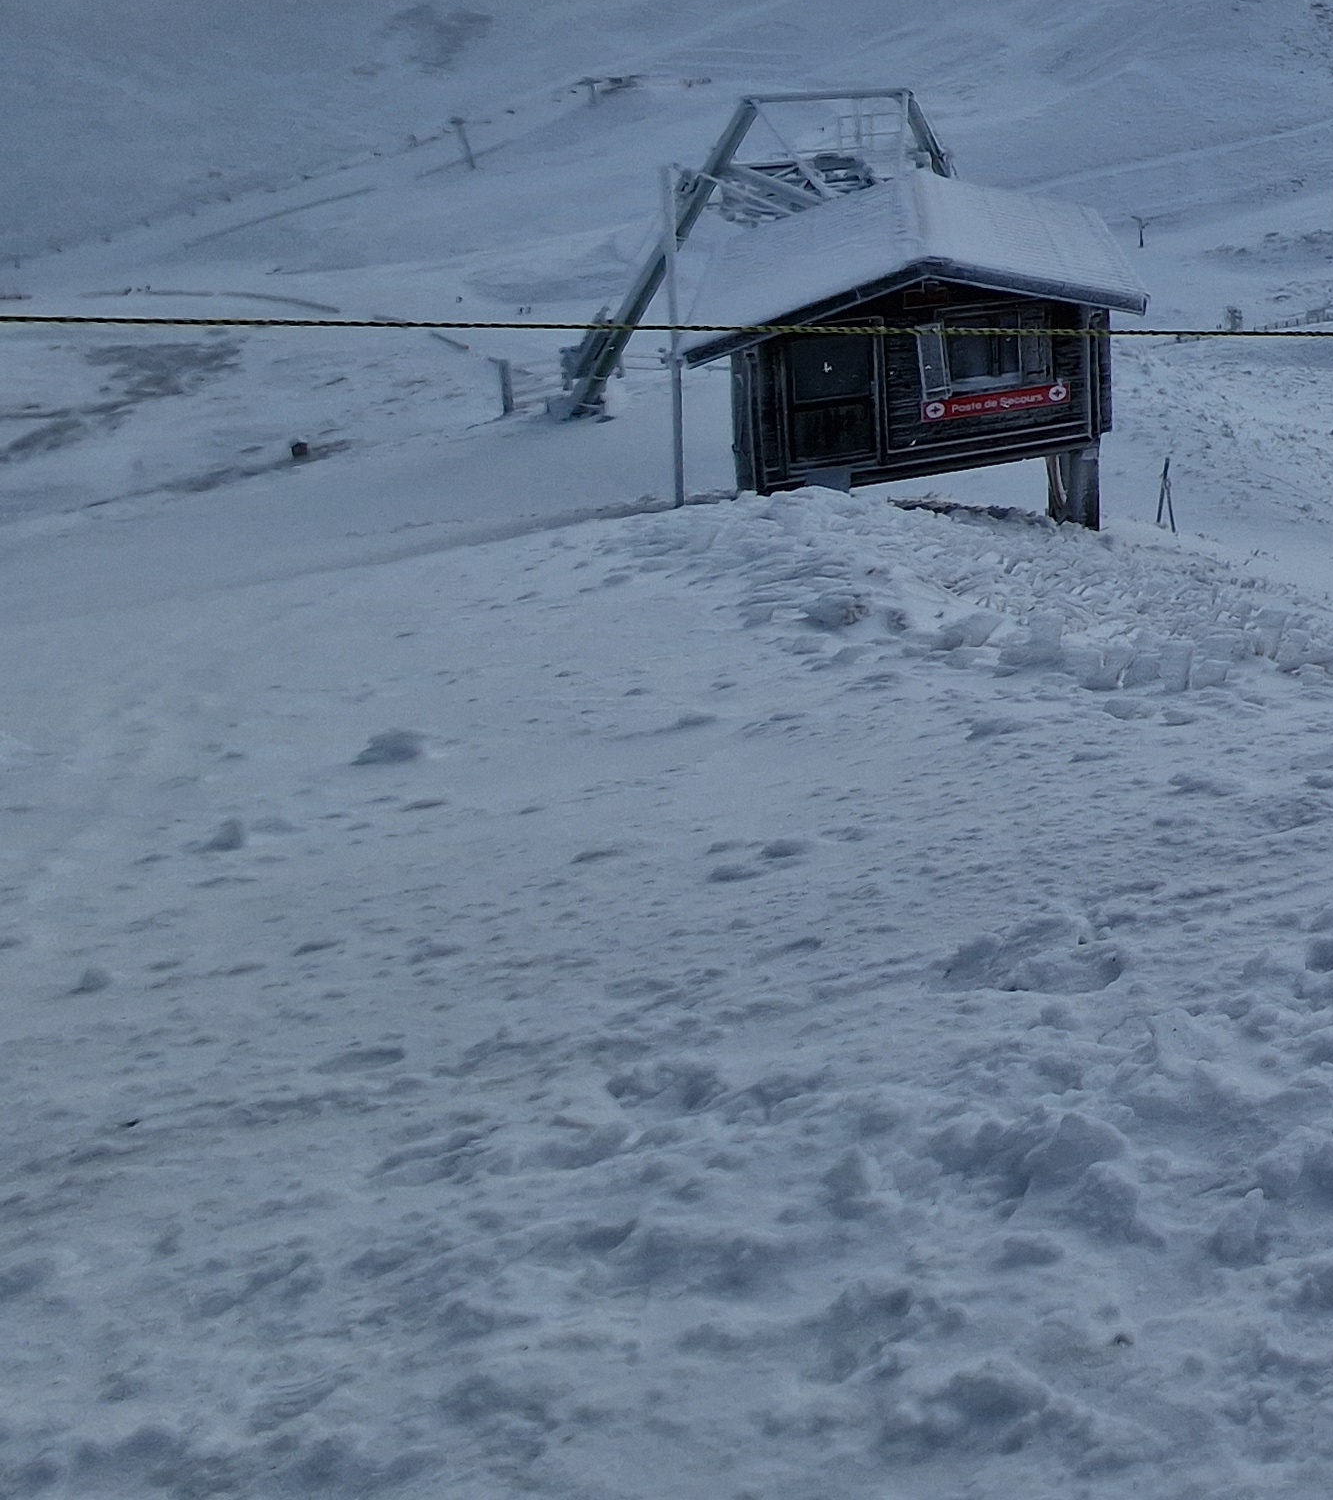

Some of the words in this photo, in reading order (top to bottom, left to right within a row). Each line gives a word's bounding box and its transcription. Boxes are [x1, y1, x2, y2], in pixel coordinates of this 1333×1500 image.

[951, 402, 982, 413] Poste
[984, 400, 998, 408] de
[999, 394, 1044, 408] Secours
